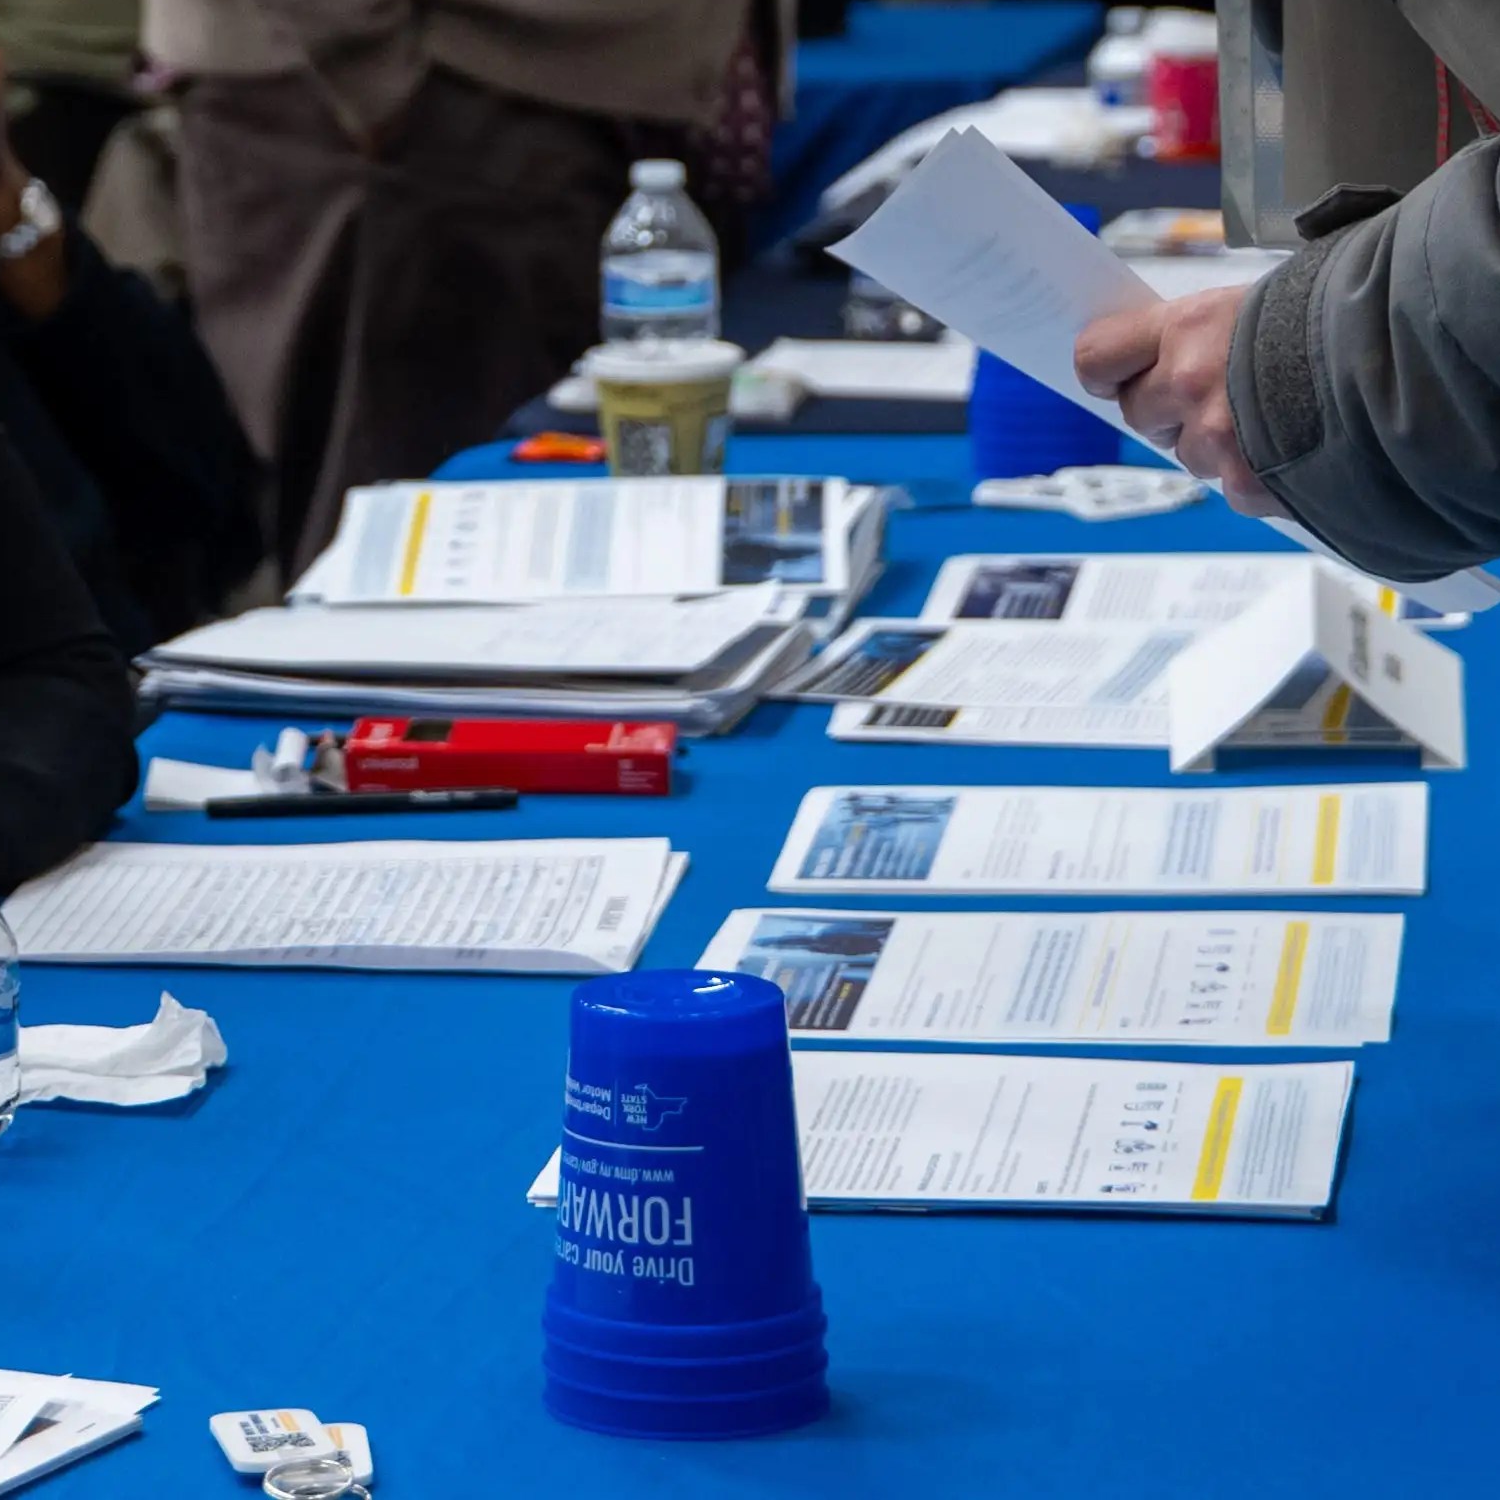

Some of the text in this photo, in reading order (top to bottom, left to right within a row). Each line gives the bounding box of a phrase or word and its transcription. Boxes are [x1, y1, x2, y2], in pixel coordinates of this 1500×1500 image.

[582, 1083, 611, 1102] Motor
[621, 1093, 648, 1104] STATE
[622, 1104, 648, 1114] YORK
[626, 1114, 648, 1124] NEW
[557, 1177, 693, 1246] FORWAR
[583, 1248, 625, 1275] your
[632, 1255, 694, 1286] Drive
